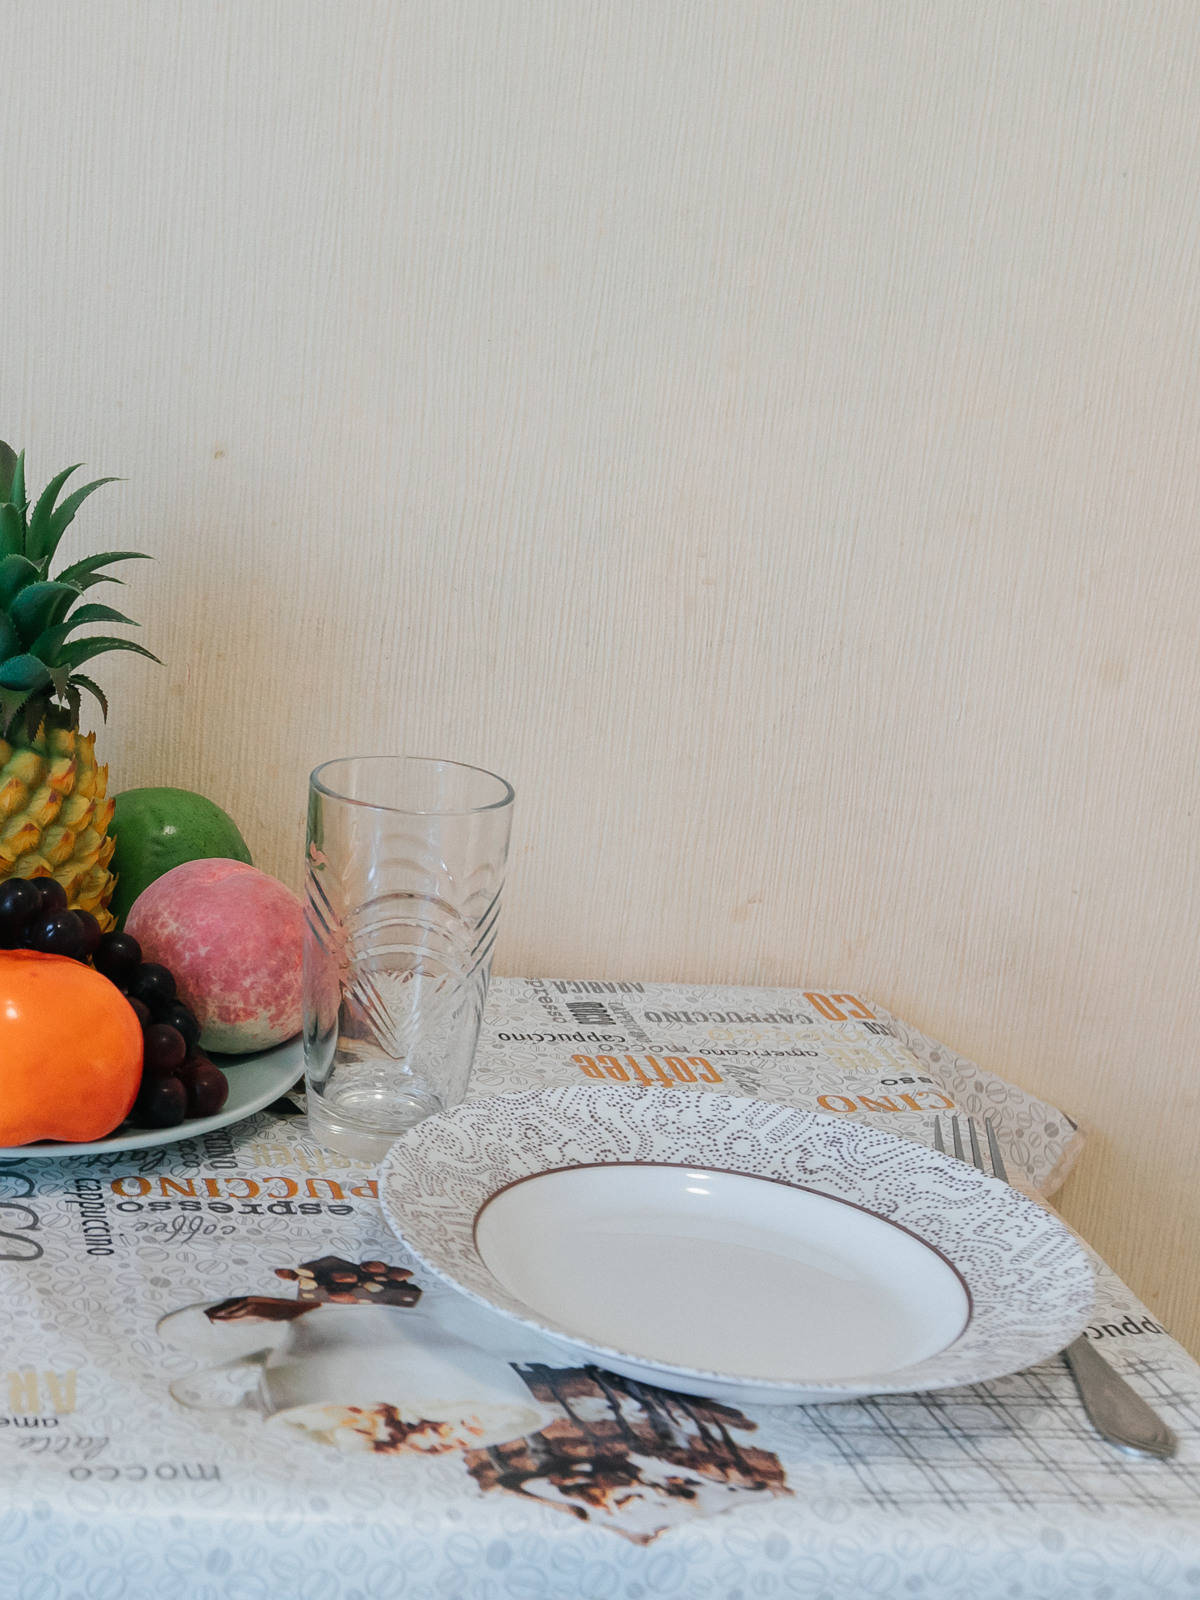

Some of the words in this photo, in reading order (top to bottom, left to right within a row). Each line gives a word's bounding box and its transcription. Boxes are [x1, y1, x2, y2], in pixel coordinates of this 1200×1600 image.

[552, 981, 646, 995] ARABICA
[525, 977, 567, 1024] presso
[644, 1010, 814, 1025] CAPPUCCINO
[498, 1031, 626, 1045] cappuccino
[699, 1048, 818, 1059] americano
[571, 1054, 723, 1088] coffee
[110, 1175, 379, 1200] PUCCINO
[63, 1177, 115, 1257] cappuccino
[116, 1200, 354, 1216] espresso
[130, 1214, 237, 1244] coffee
[67, 1462, 222, 1484] mocco
